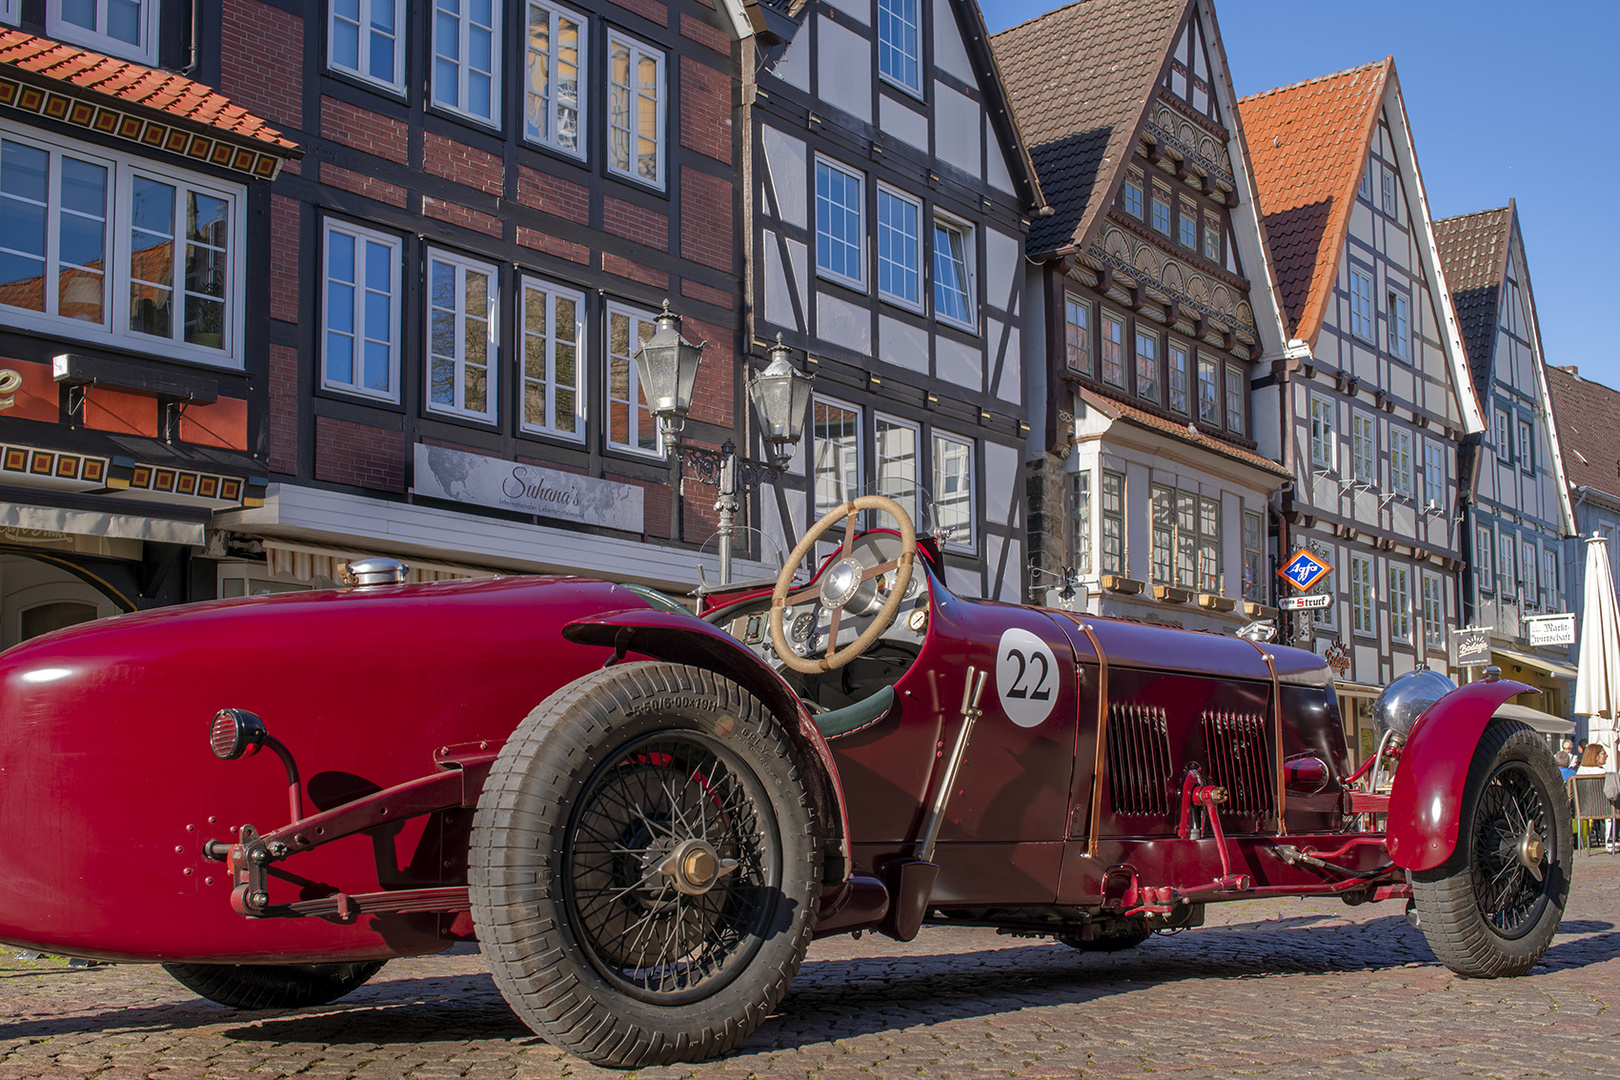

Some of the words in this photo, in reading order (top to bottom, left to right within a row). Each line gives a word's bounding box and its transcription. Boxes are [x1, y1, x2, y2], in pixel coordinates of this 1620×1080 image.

[501, 466, 581, 507] Suhana's
[1287, 562, 1318, 582] Agfa
[1459, 642, 1488, 655] Bodega
[1005, 649, 1051, 701] 22
